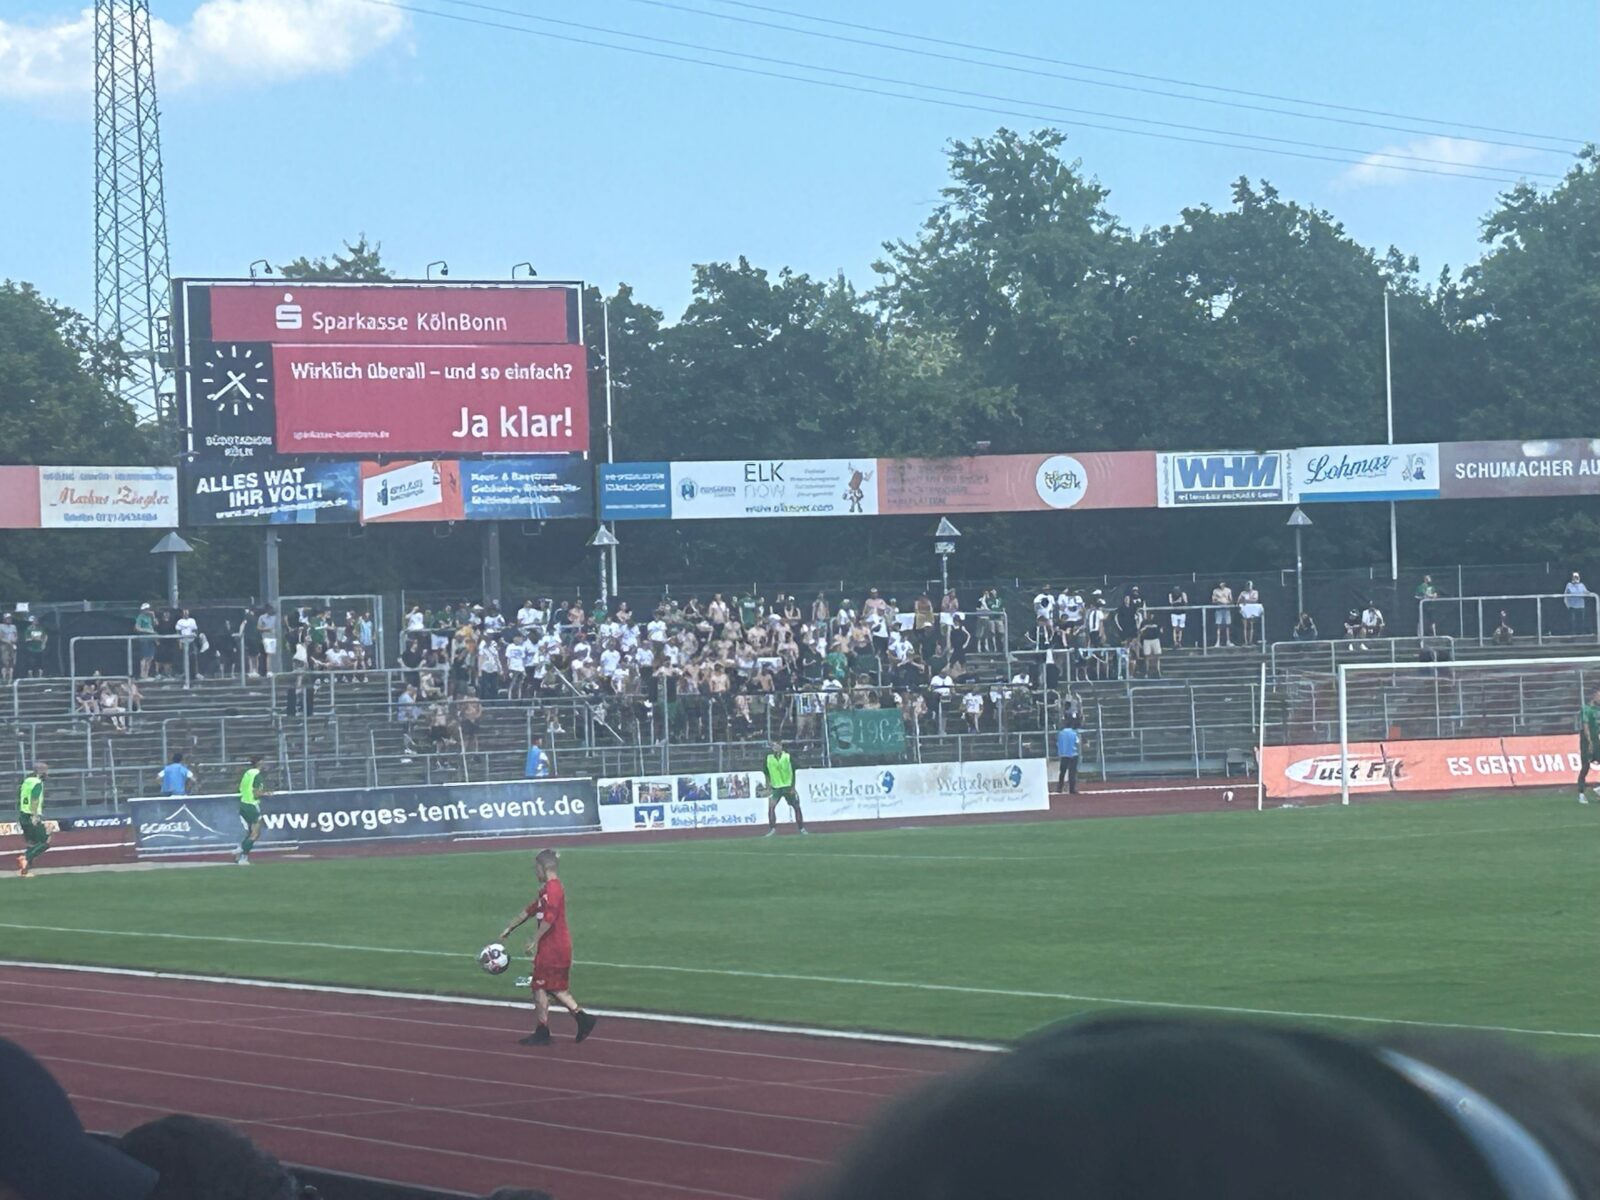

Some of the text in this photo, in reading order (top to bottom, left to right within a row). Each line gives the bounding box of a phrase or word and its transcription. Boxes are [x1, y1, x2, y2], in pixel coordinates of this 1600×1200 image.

[312, 311, 508, 333] Sparkasse KölnBonn
[291, 361, 362, 379] Wirklich
[367, 361, 426, 379] überall
[444, 362, 476, 379] und
[480, 366, 501, 379] so
[505, 362, 573, 379] einfach?
[452, 406, 573, 438] Ja klar!
[196, 472, 258, 494] ALLES
[264, 467, 306, 487] WAT
[744, 462, 785, 482] ELK
[1177, 455, 1279, 489] WHM
[1455, 459, 1573, 479] SCHUMACHER
[229, 482, 323, 508] IHR VOLT!
[1447, 756, 1473, 776] ES
[1476, 755, 1527, 775] GEHT
[1531, 753, 1565, 772] UM
[241, 795, 585, 832] ww.gorges-tent-event.de
